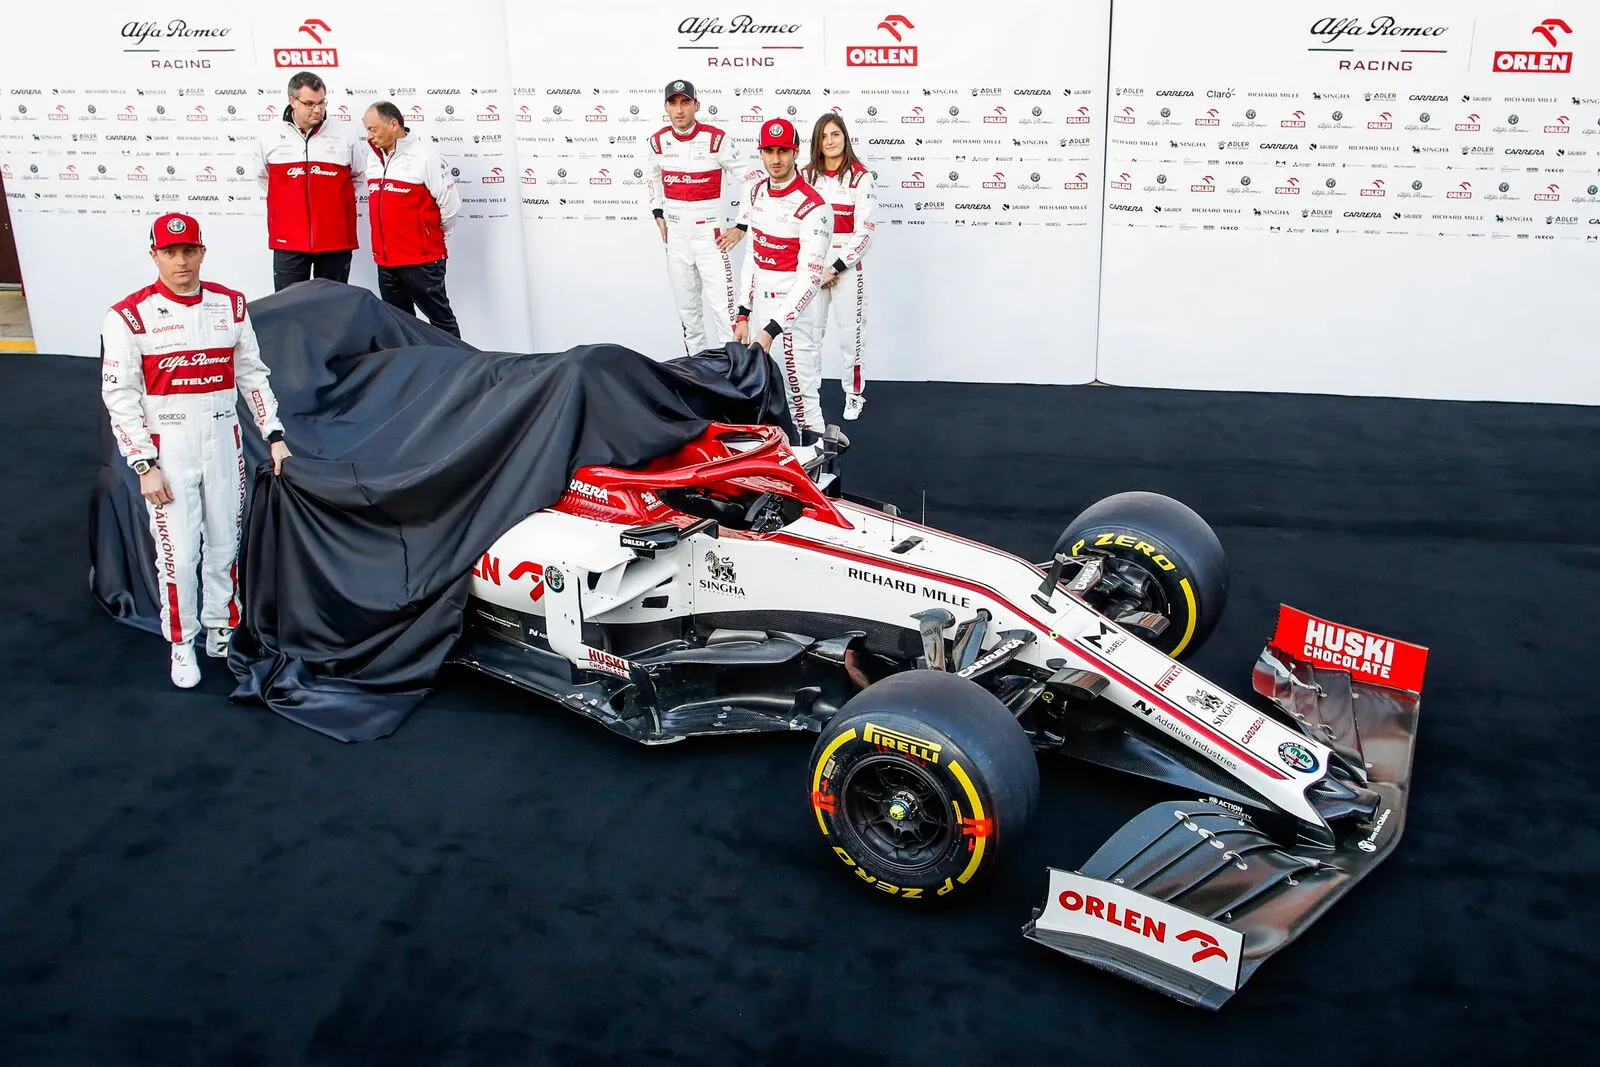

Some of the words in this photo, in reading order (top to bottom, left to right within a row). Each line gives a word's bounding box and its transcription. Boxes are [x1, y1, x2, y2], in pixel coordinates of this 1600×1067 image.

[121, 20, 164, 45] Alfa
[167, 19, 232, 38] Romeo
[677, 16, 727, 42] Alfa
[728, 14, 802, 34] Romeo
[1309, 17, 1366, 44] Alfa
[1367, 16, 1449, 37] Romeo
[151, 59, 212, 69] RACING
[276, 50, 336, 66] ORLEN
[708, 57, 775, 67] RACING
[849, 48, 914, 65] ORLEN
[1496, 53, 1569, 71] ORLEN
[1338, 60, 1413, 71] RACING
[1206, 89, 1232, 98] Claro
[902, 116, 924, 124] ORLEN
[985, 116, 1006, 124] ORLEN
[1282, 120, 1304, 128] ORLEN
[1368, 122, 1391, 130] ORLEN
[1456, 124, 1480, 132] ORLEN
[1545, 126, 1568, 134] ORLEN
[664, 175, 682, 186] Alfa
[682, 175, 711, 184] Romeo
[902, 181, 924, 189] ORLEN
[1066, 182, 1087, 190] ORLEN
[1276, 187, 1298, 195] ORLEN
[1361, 189, 1384, 197] ORLEN
[1448, 191, 1471, 199] ORLEN
[721, 249, 733, 283] KUBICA
[727, 286, 735, 322] ROBERT
[158, 353, 191, 373] Alfa
[190, 352, 231, 367] Romeo
[783, 332, 800, 394] GIOVINAZZI
[171, 375, 223, 386] STELVIO
[252, 390, 266, 417] ORLEN
[622, 538, 645, 547] ORLEN
[1095, 533, 1176, 571] ZERO
[699, 579, 746, 596] SINGHA
[848, 567, 916, 595] RICHARD
[923, 587, 970, 609] MILLE
[1305, 619, 1395, 666] HUSKI
[588, 649, 625, 669] HUSKI
[957, 637, 1025, 678] CARRERA
[1303, 644, 1391, 679] CHOCOLATE
[1154, 664, 1183, 692] PIRELLI
[1213, 701, 1239, 727] SINGHA
[1241, 716, 1265, 745] CARRERA
[863, 722, 942, 764] PIRELLI
[1155, 714, 1192, 742] Additive
[1192, 738, 1238, 771] Industries
[1219, 800, 1243, 813] ACTION
[832, 846, 924, 899] ZERO
[1058, 890, 1167, 943] ORLEN
